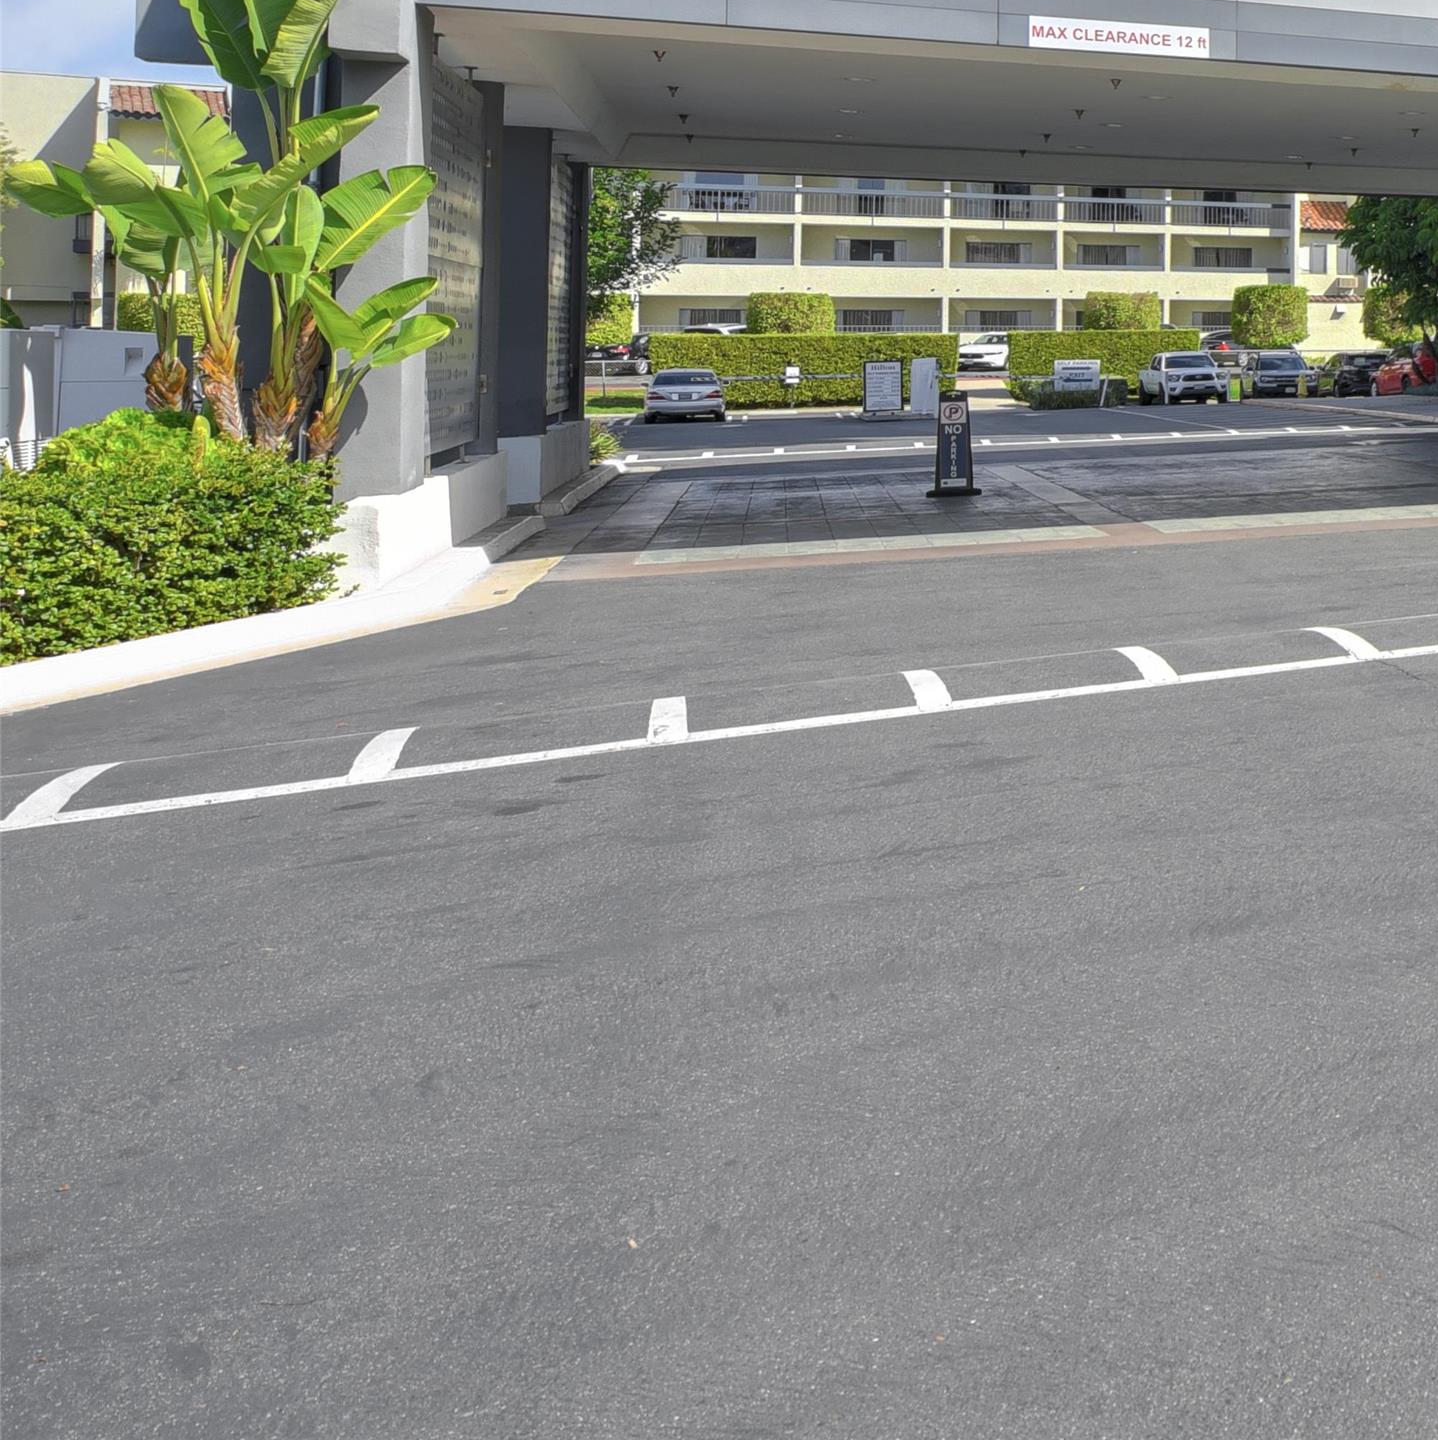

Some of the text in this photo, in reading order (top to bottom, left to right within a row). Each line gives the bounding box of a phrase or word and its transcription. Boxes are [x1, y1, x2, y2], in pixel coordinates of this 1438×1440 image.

[1031, 25, 1207, 49] MAX CLEARANCE 12 ft
[944, 424, 962, 435] NO
